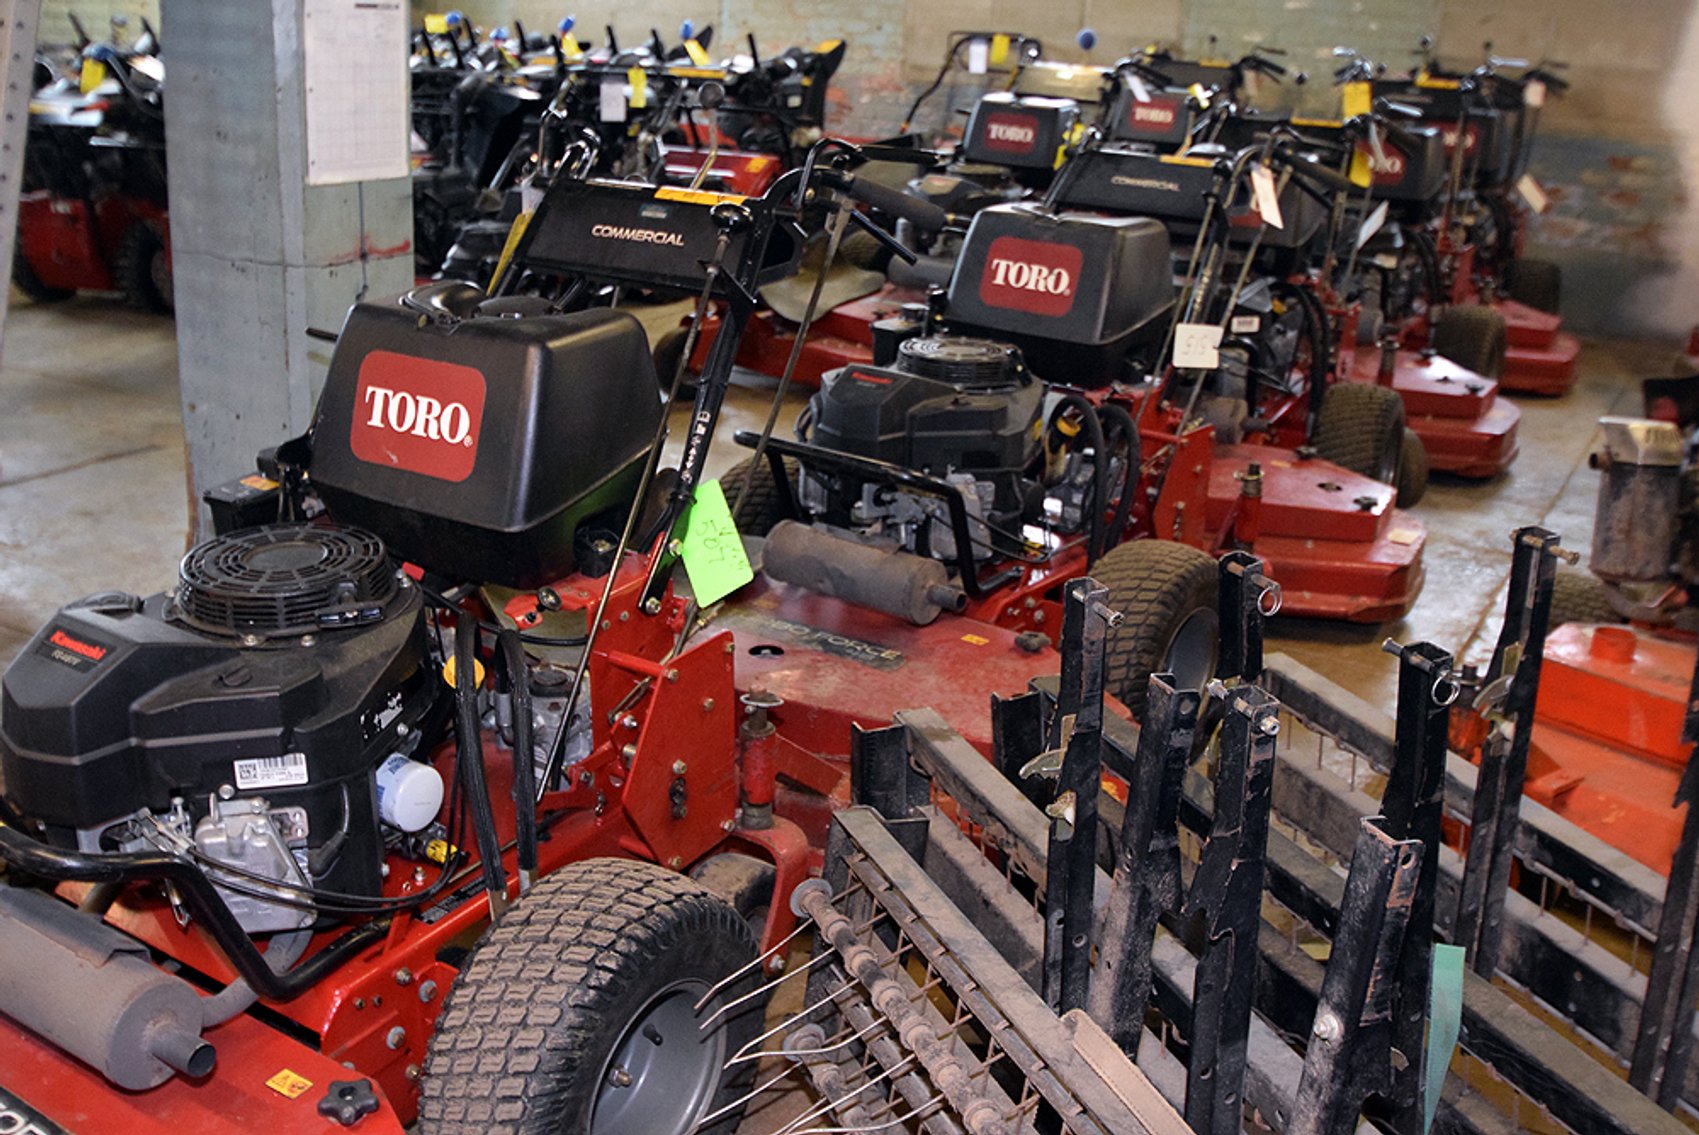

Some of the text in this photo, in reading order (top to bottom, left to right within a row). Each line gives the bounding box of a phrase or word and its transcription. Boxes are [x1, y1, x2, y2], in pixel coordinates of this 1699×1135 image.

[987, 123, 1035, 143] TORO
[591, 224, 685, 247] COMMERCIAL
[991, 258, 1070, 295] TORO
[365, 385, 471, 445] TORO
[50, 629, 107, 661] Kawasaki
[814, 630, 901, 661] FORCE
